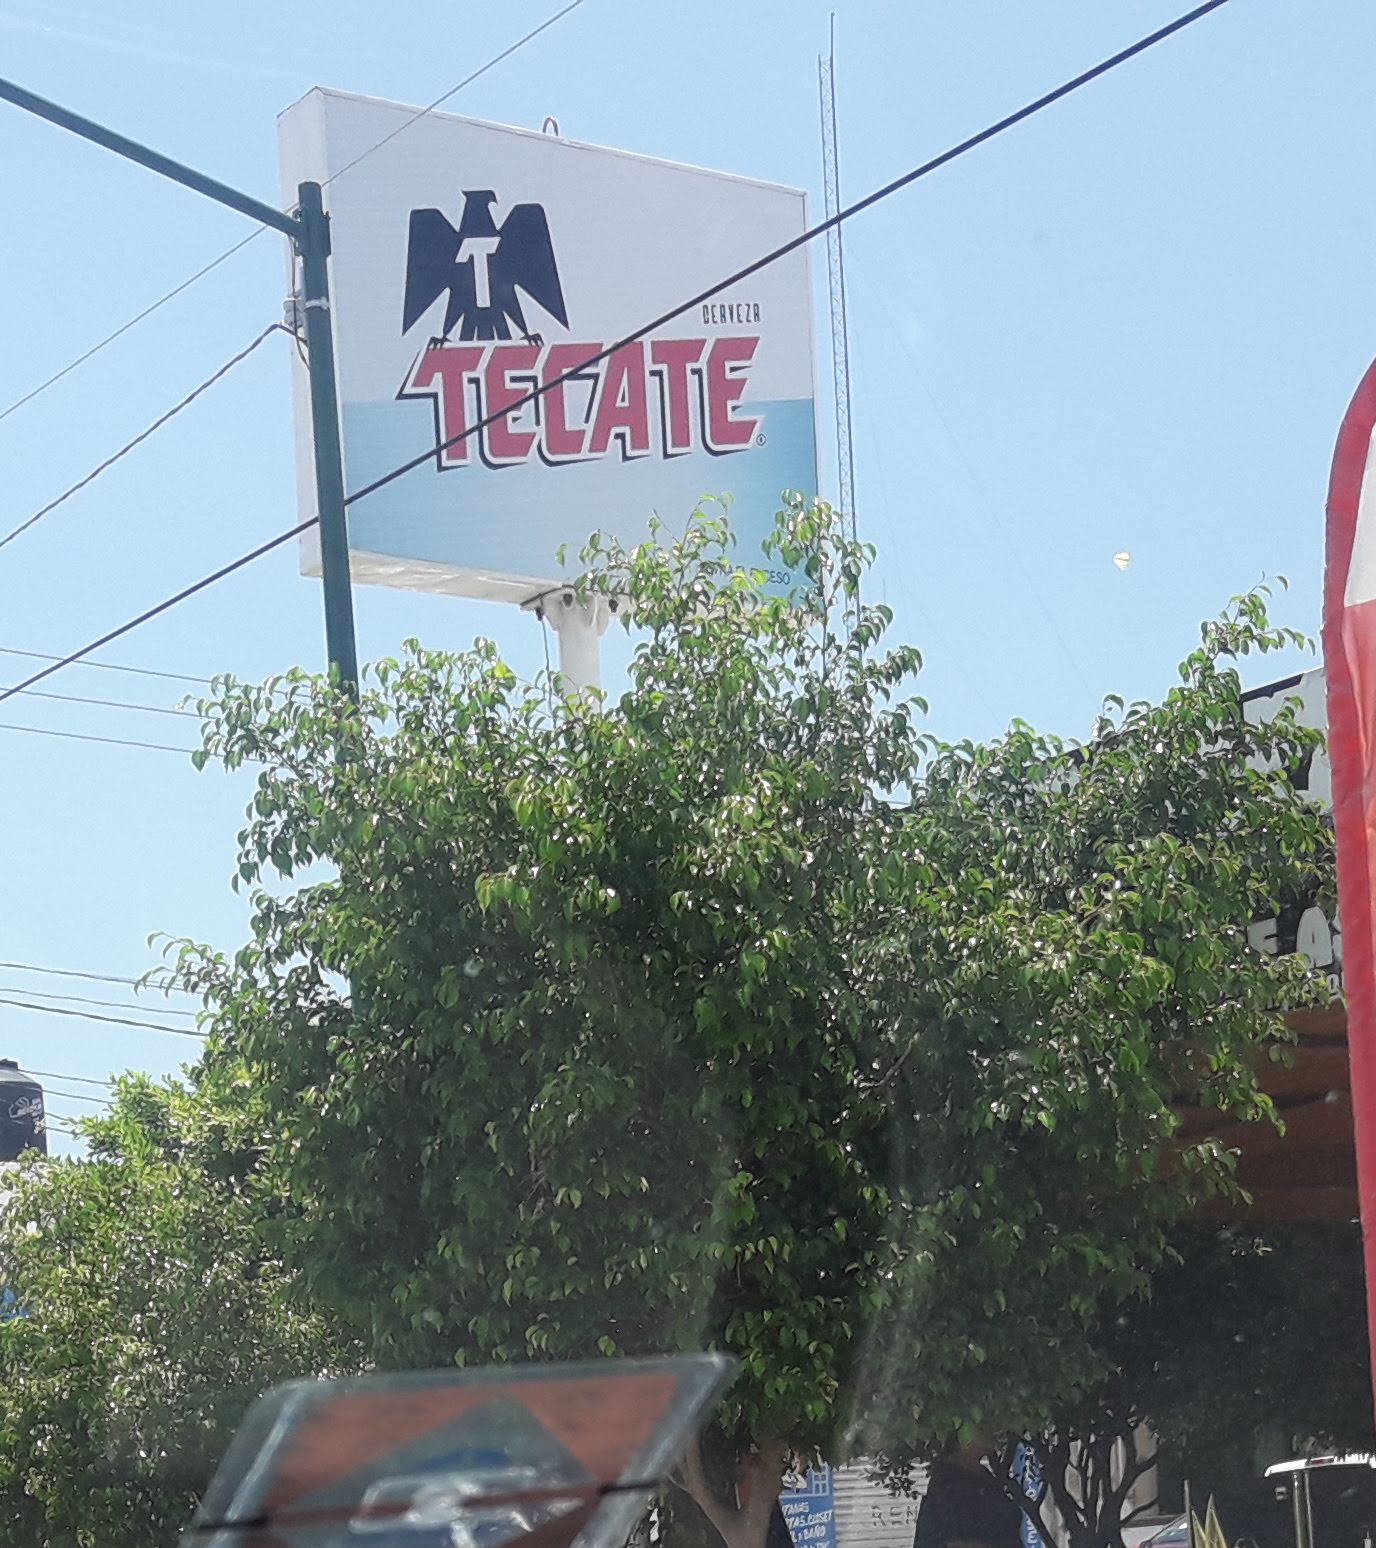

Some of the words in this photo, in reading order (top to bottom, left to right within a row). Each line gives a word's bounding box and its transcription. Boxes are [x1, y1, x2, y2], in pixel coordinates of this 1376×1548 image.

[455, 237, 501, 308] T
[703, 303, 762, 326] CERVEZA
[397, 336, 761, 472] TECATE
[872, 1505, 918, 1527] REN
